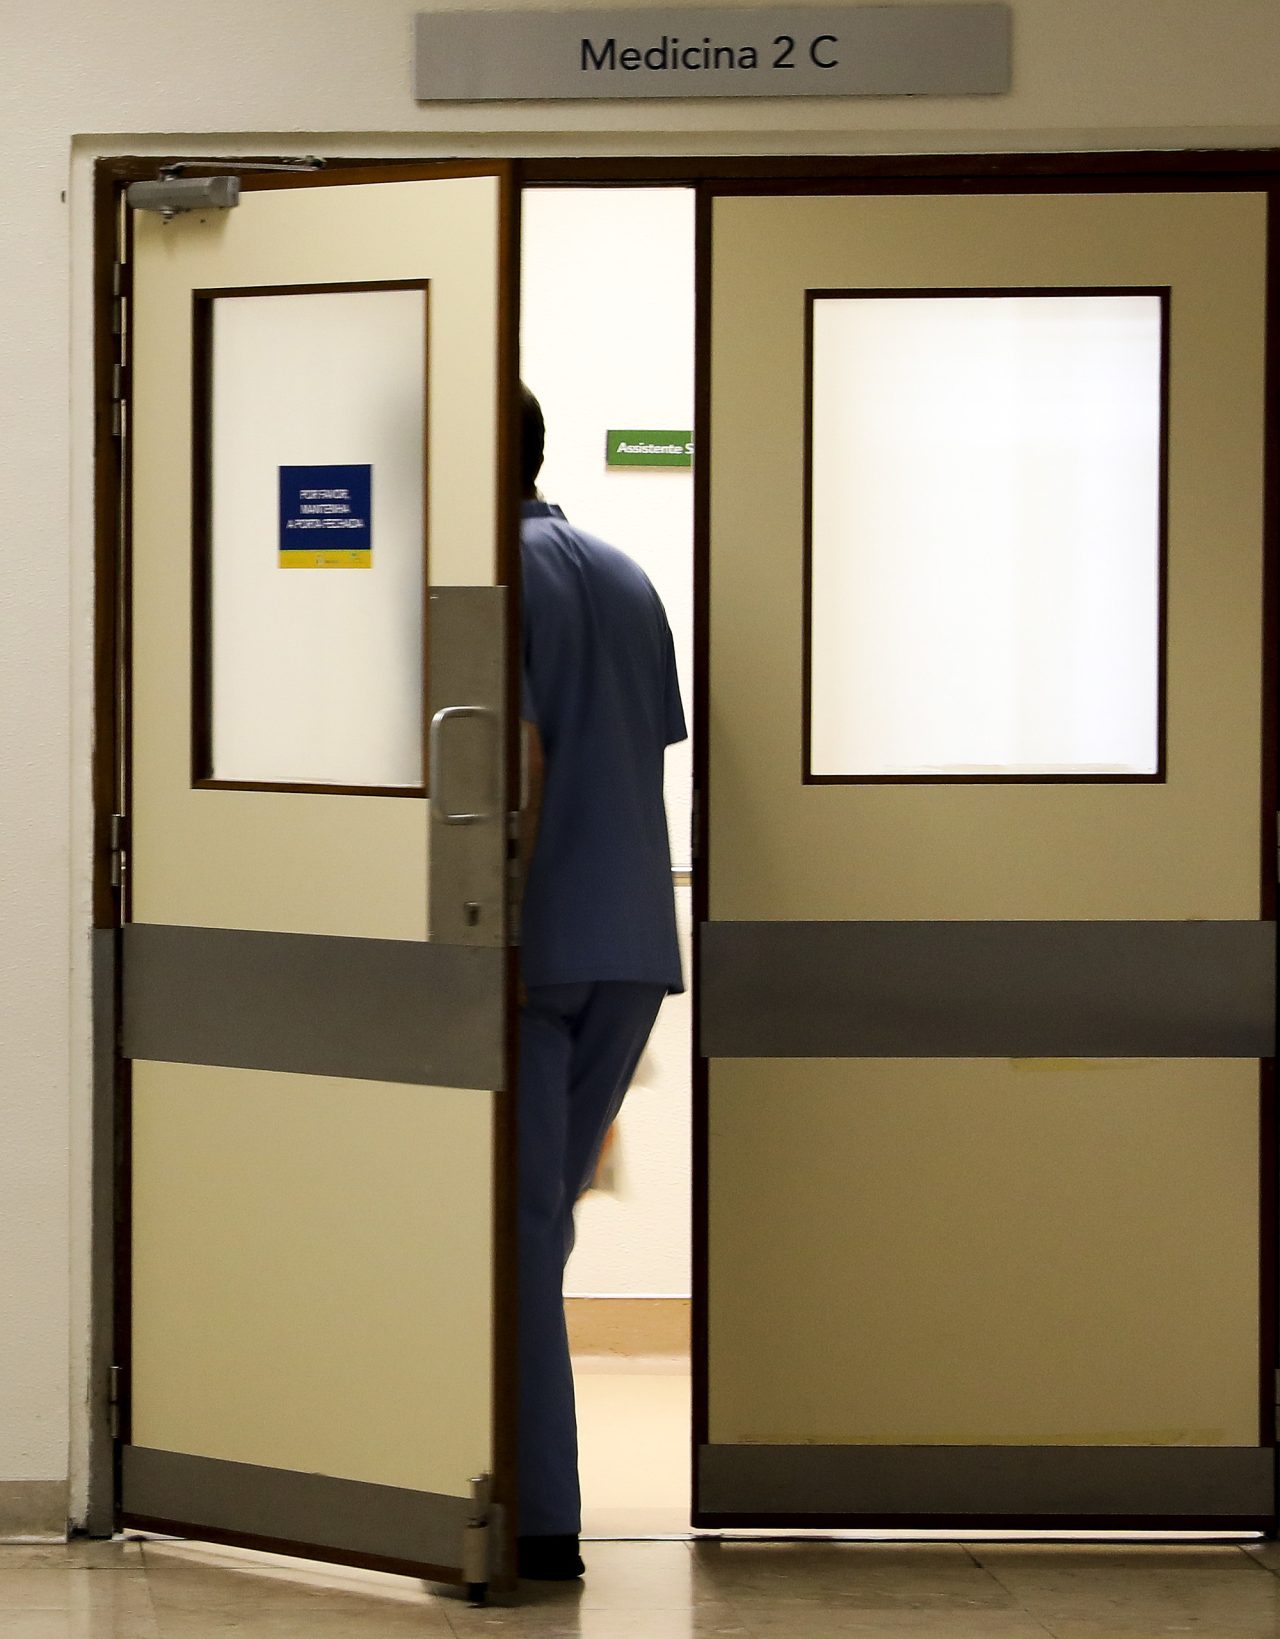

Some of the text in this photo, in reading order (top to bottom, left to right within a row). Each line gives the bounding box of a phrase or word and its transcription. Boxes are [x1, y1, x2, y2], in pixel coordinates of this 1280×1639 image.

[581, 35, 839, 71] Medicina 2 C
[616, 441, 683, 454] Assistente
[299, 504, 352, 514] MANTENHA
